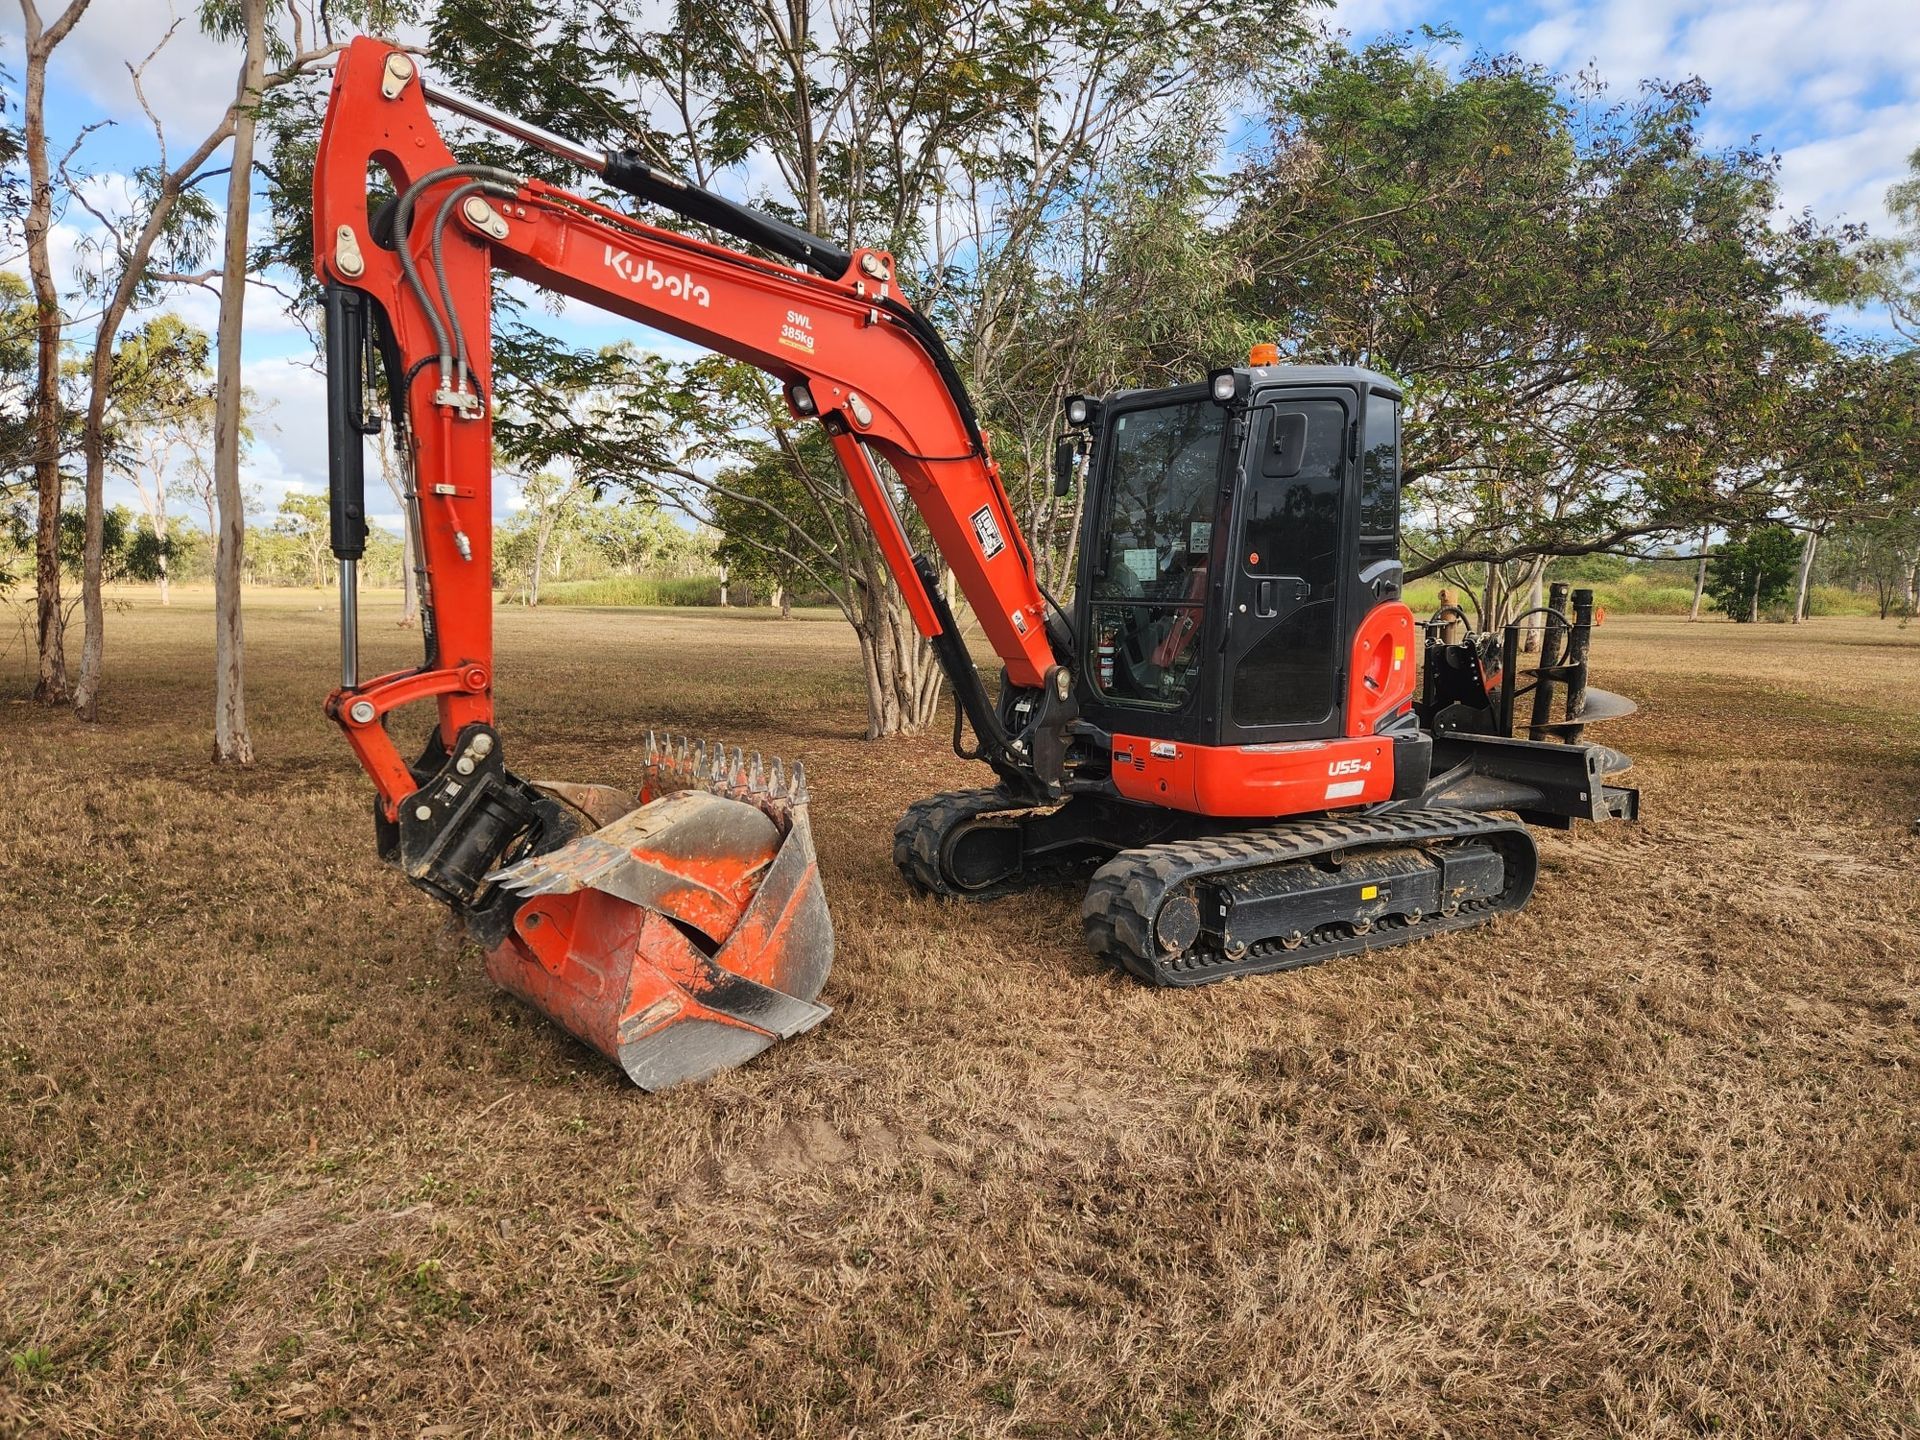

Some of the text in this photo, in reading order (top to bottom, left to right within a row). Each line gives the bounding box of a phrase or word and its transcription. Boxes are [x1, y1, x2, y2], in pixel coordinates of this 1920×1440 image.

[604, 244, 710, 308] Kubota
[786, 310, 813, 330] SWL
[781, 324, 815, 349] 385kg
[1328, 758, 1372, 776] U55-4
